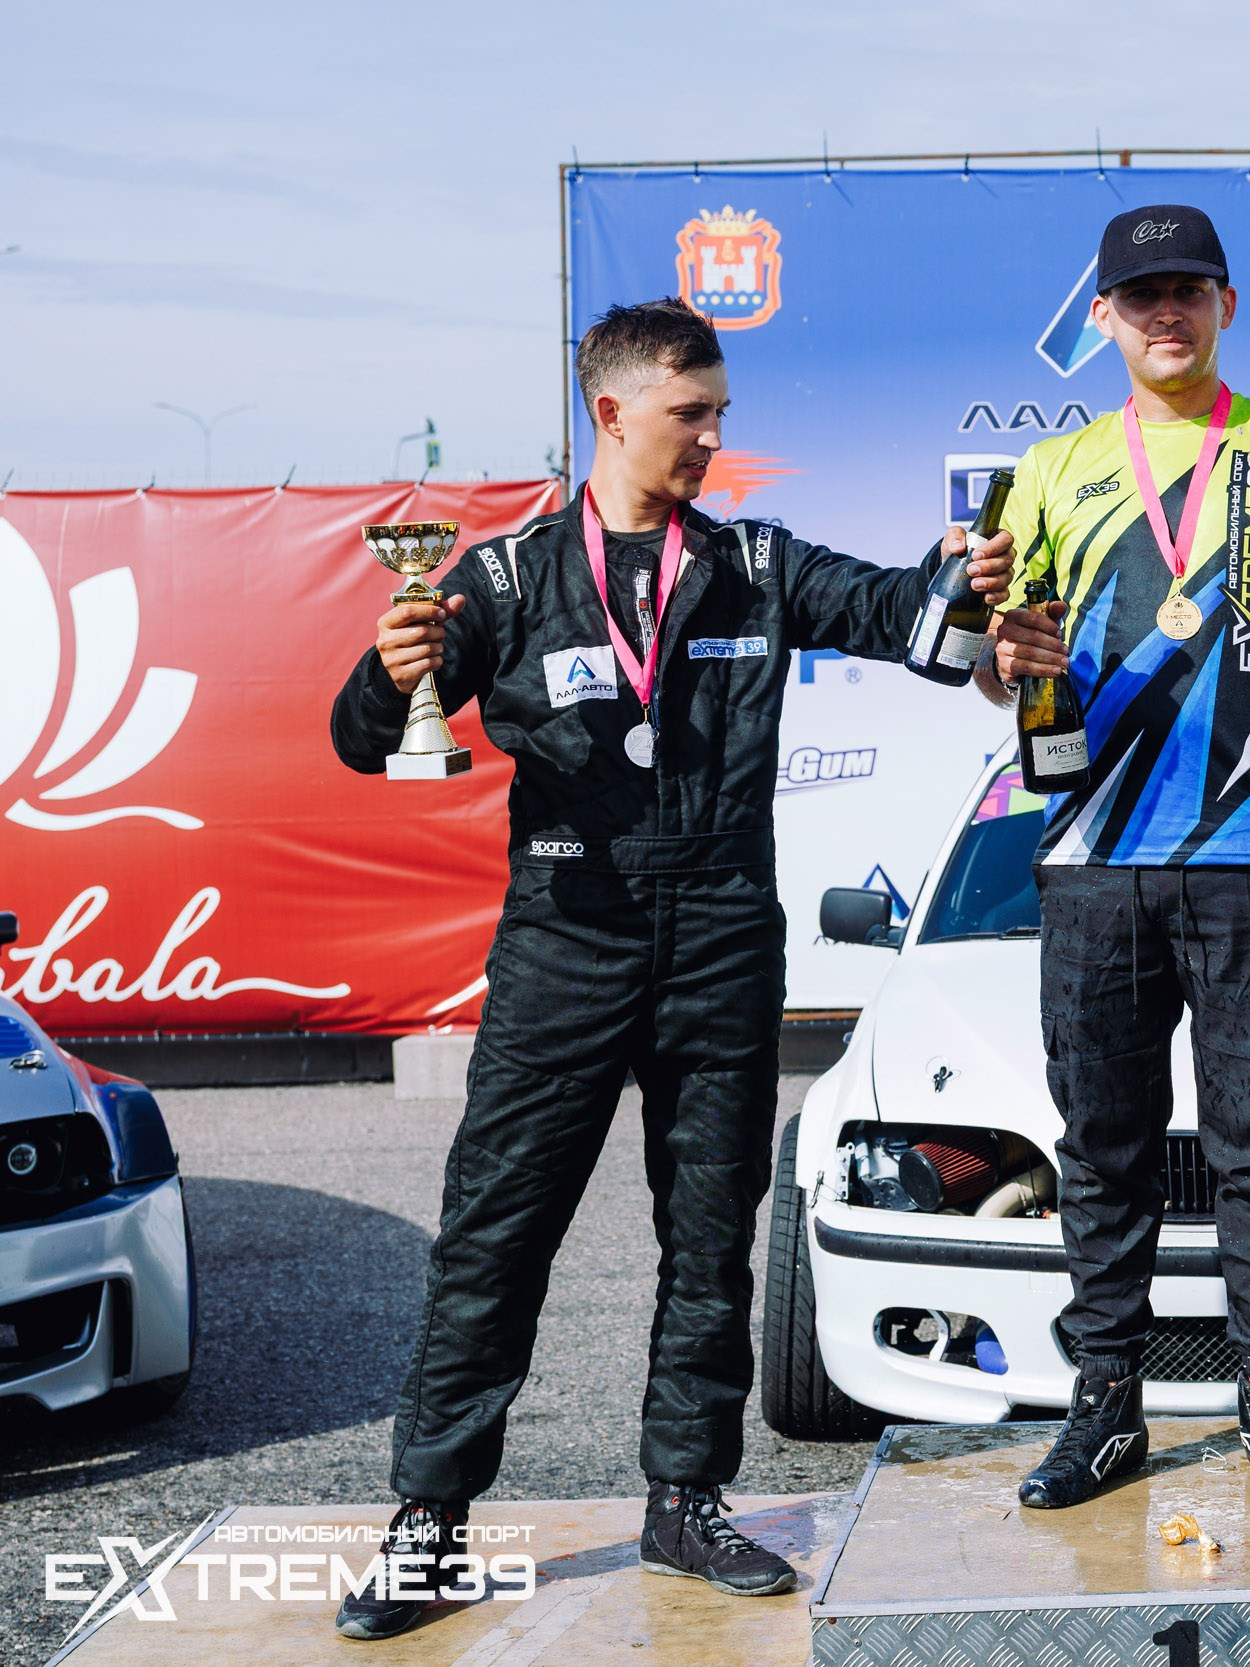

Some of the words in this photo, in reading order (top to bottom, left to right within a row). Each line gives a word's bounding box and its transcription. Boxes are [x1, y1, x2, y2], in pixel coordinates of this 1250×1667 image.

[1233, 451, 1245, 482] СПОРТ
[755, 526, 774, 570] sparco
[1228, 484, 1242, 590] АВТОМОБИЛЬНЫЙ
[477, 547, 510, 593] sparco
[529, 840, 584, 857] sparco
[0, 886, 351, 1003] bala
